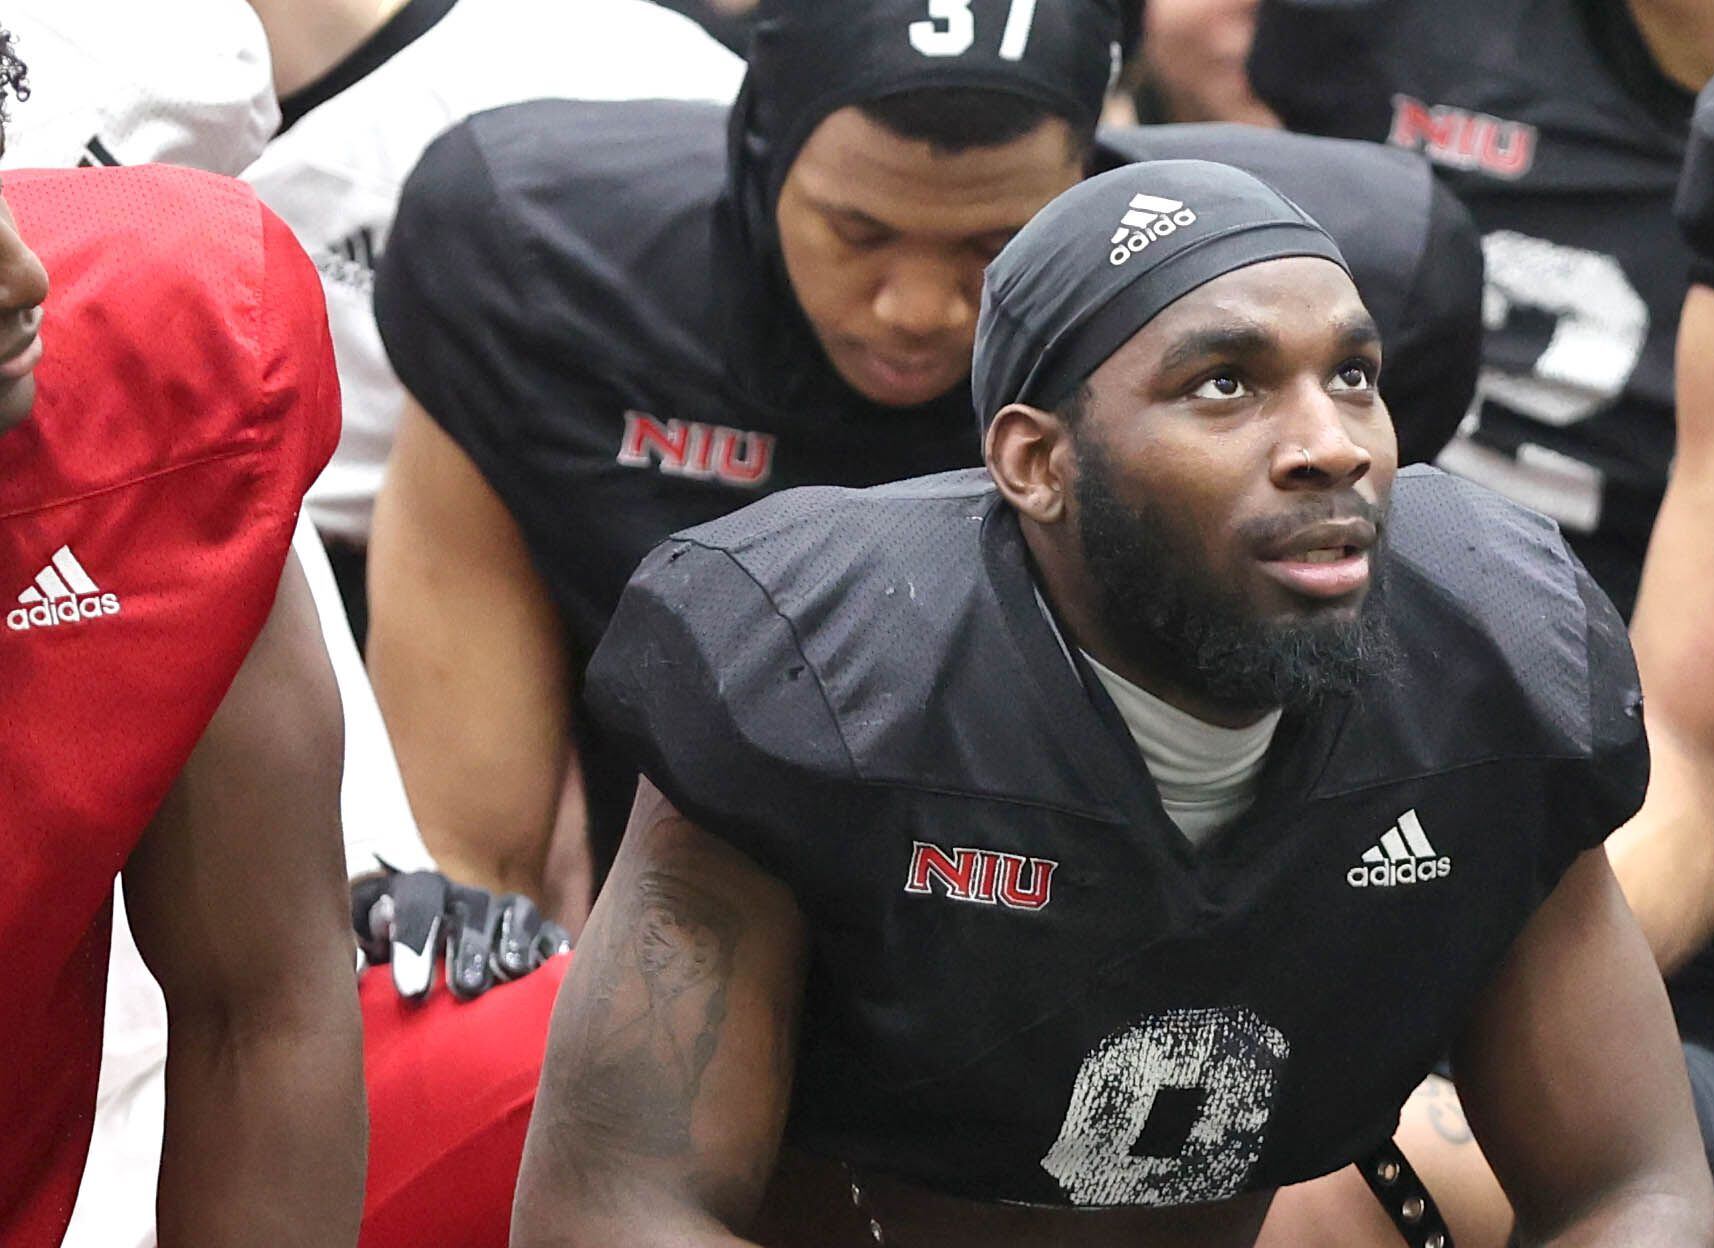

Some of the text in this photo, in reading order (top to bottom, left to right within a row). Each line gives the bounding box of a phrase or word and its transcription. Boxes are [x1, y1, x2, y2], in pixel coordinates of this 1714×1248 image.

[1385, 93, 1539, 181] NIU
[616, 409, 776, 488] NIU
[7, 593, 121, 631] adidas
[904, 840, 1059, 912] NIU
[1346, 856, 1451, 888] adidas
